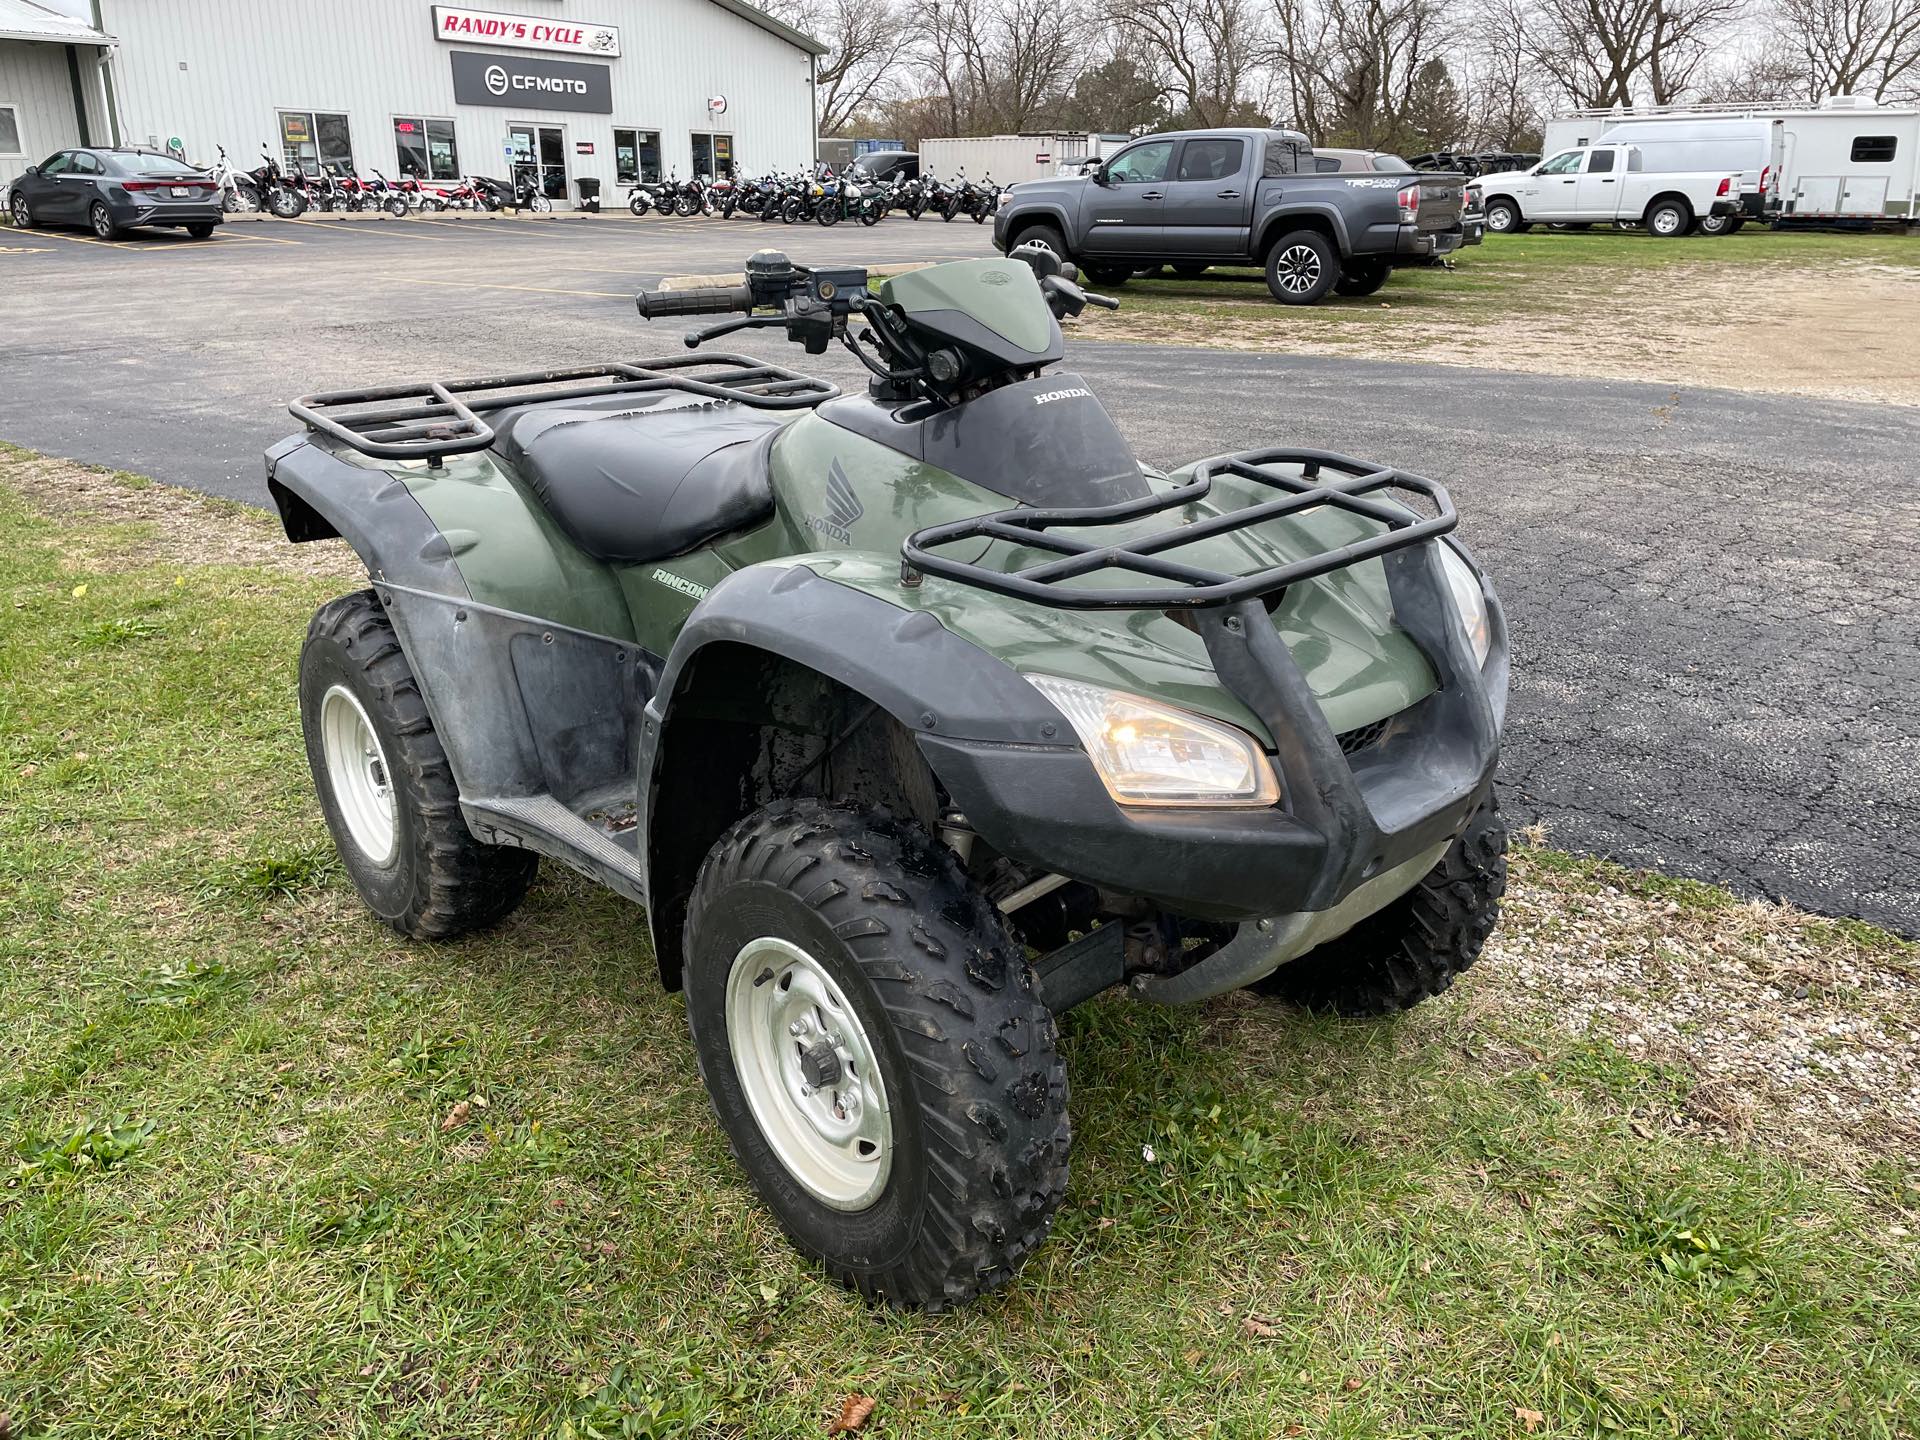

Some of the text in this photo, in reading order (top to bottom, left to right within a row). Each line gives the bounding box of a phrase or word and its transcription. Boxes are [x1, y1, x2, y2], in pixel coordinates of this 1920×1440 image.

[444, 15, 584, 45] RANDY'S CYCLE
[512, 75, 587, 94] CFMOTO
[1033, 388, 1092, 405] HONDA
[804, 514, 851, 546] HONDA
[651, 568, 709, 600] RINCON
